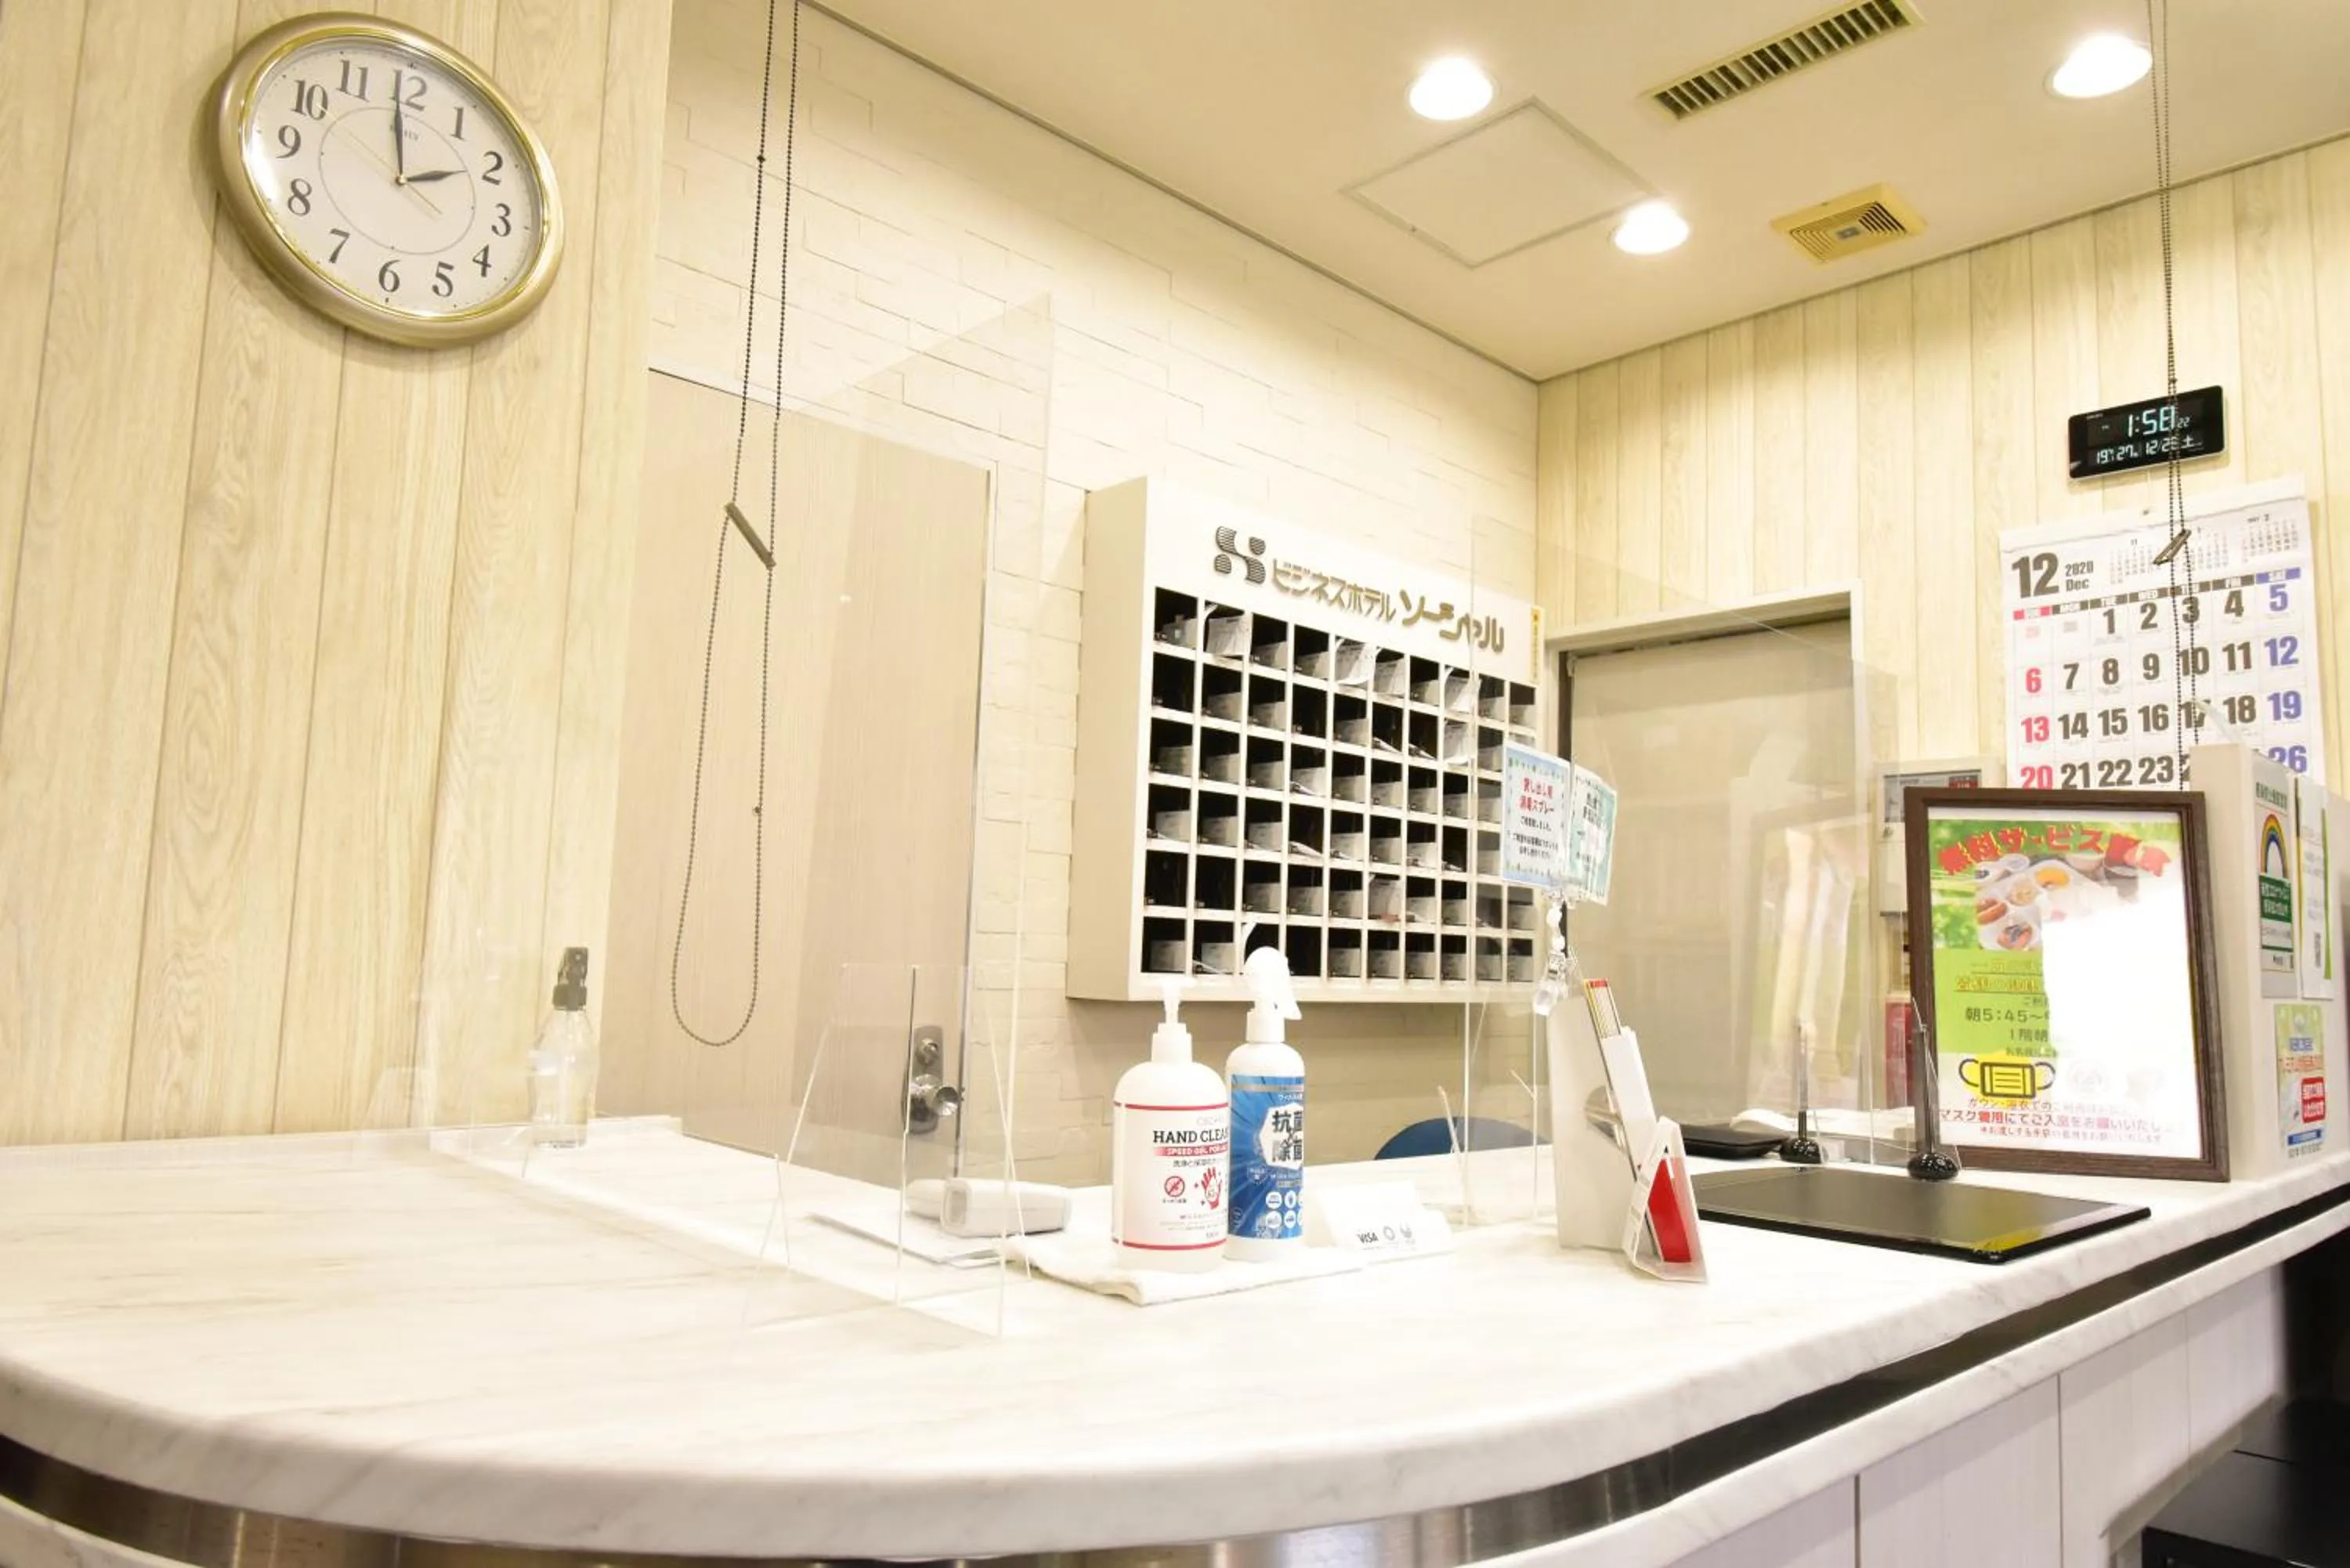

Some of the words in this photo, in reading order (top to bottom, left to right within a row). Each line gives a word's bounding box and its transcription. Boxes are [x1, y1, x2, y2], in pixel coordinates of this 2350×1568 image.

[336, 60, 371, 103] 11
[389, 69, 427, 111] 12
[291, 79, 329, 121] 10
[450, 107, 466, 141] 1
[275, 125, 302, 160] 9
[481, 150, 504, 186] 2
[287, 177, 313, 217] 8
[490, 202, 512, 238] 3
[327, 227, 351, 265] 7
[472, 244, 493, 278] 4
[378, 259, 402, 294] 6
[432, 261, 454, 298] 5
[2128, 405, 2176, 438] 1:58
[2012, 552, 2059, 598] 12
[2065, 560, 2094, 577] 2020
[2066, 578, 2090, 592] Dec
[1272, 558, 1397, 623] ビジネスホテル
[2103, 609, 2116, 634] 1
[2140, 602, 2158, 630] 2
[2182, 596, 2200, 624] 3
[2224, 590, 2244, 618] 4
[2269, 583, 2289, 612] 5
[2026, 667, 2042, 694] 6
[2063, 663, 2080, 690] 7
[2102, 658, 2120, 685] 8
[2142, 652, 2160, 681] 9
[2179, 646, 2210, 677] 10
[2222, 641, 2252, 671] 11
[2265, 635, 2299, 667] 12
[2020, 716, 2050, 743] 13
[2058, 712, 2089, 740] 14
[2098, 707, 2128, 737] 15
[2138, 703, 2170, 732] 16
[2222, 695, 2257, 724] 18
[2269, 690, 2302, 721] 19
[2020, 764, 2053, 789] 20
[2060, 761, 2091, 789] 21
[2097, 759, 2133, 787] 22
[2138, 755, 2174, 784] 23
[1153, 1130, 1198, 1143] HAND
[1357, 1232, 1379, 1244] VISA
